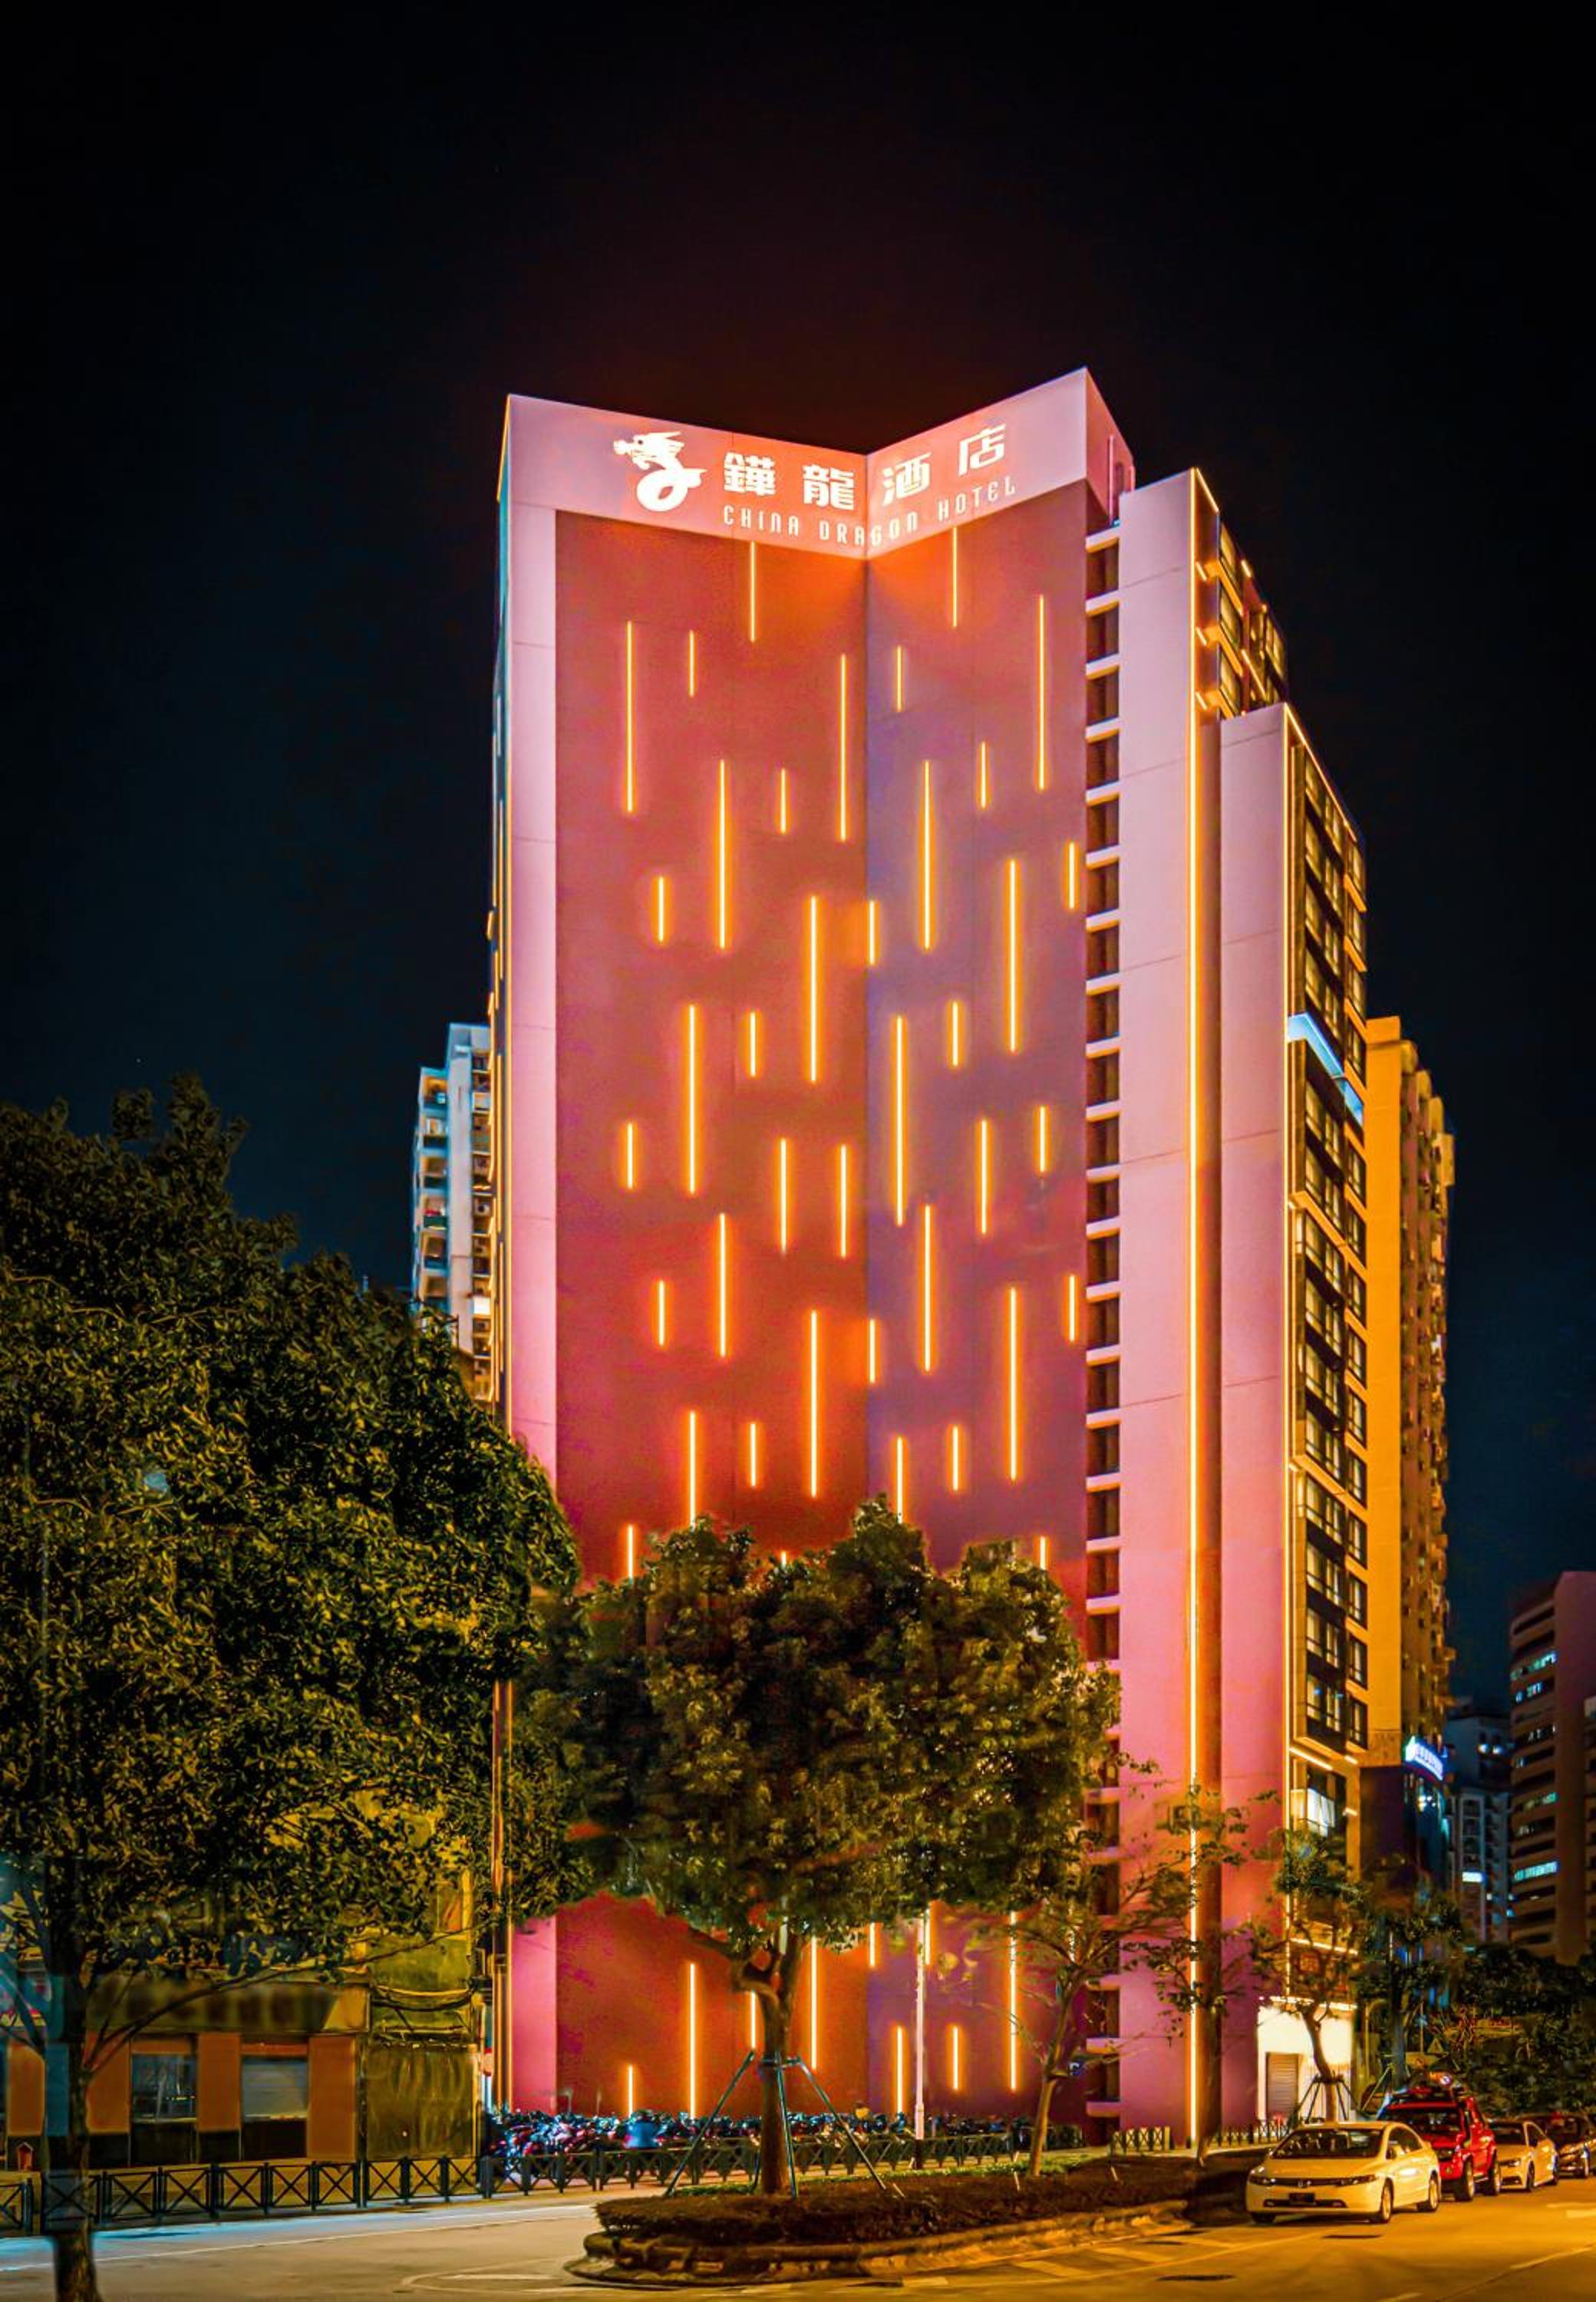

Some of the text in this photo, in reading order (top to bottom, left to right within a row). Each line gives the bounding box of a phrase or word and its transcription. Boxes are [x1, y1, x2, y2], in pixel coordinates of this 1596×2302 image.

[724, 475, 1017, 546] CHINA DRAGON HOTEL
